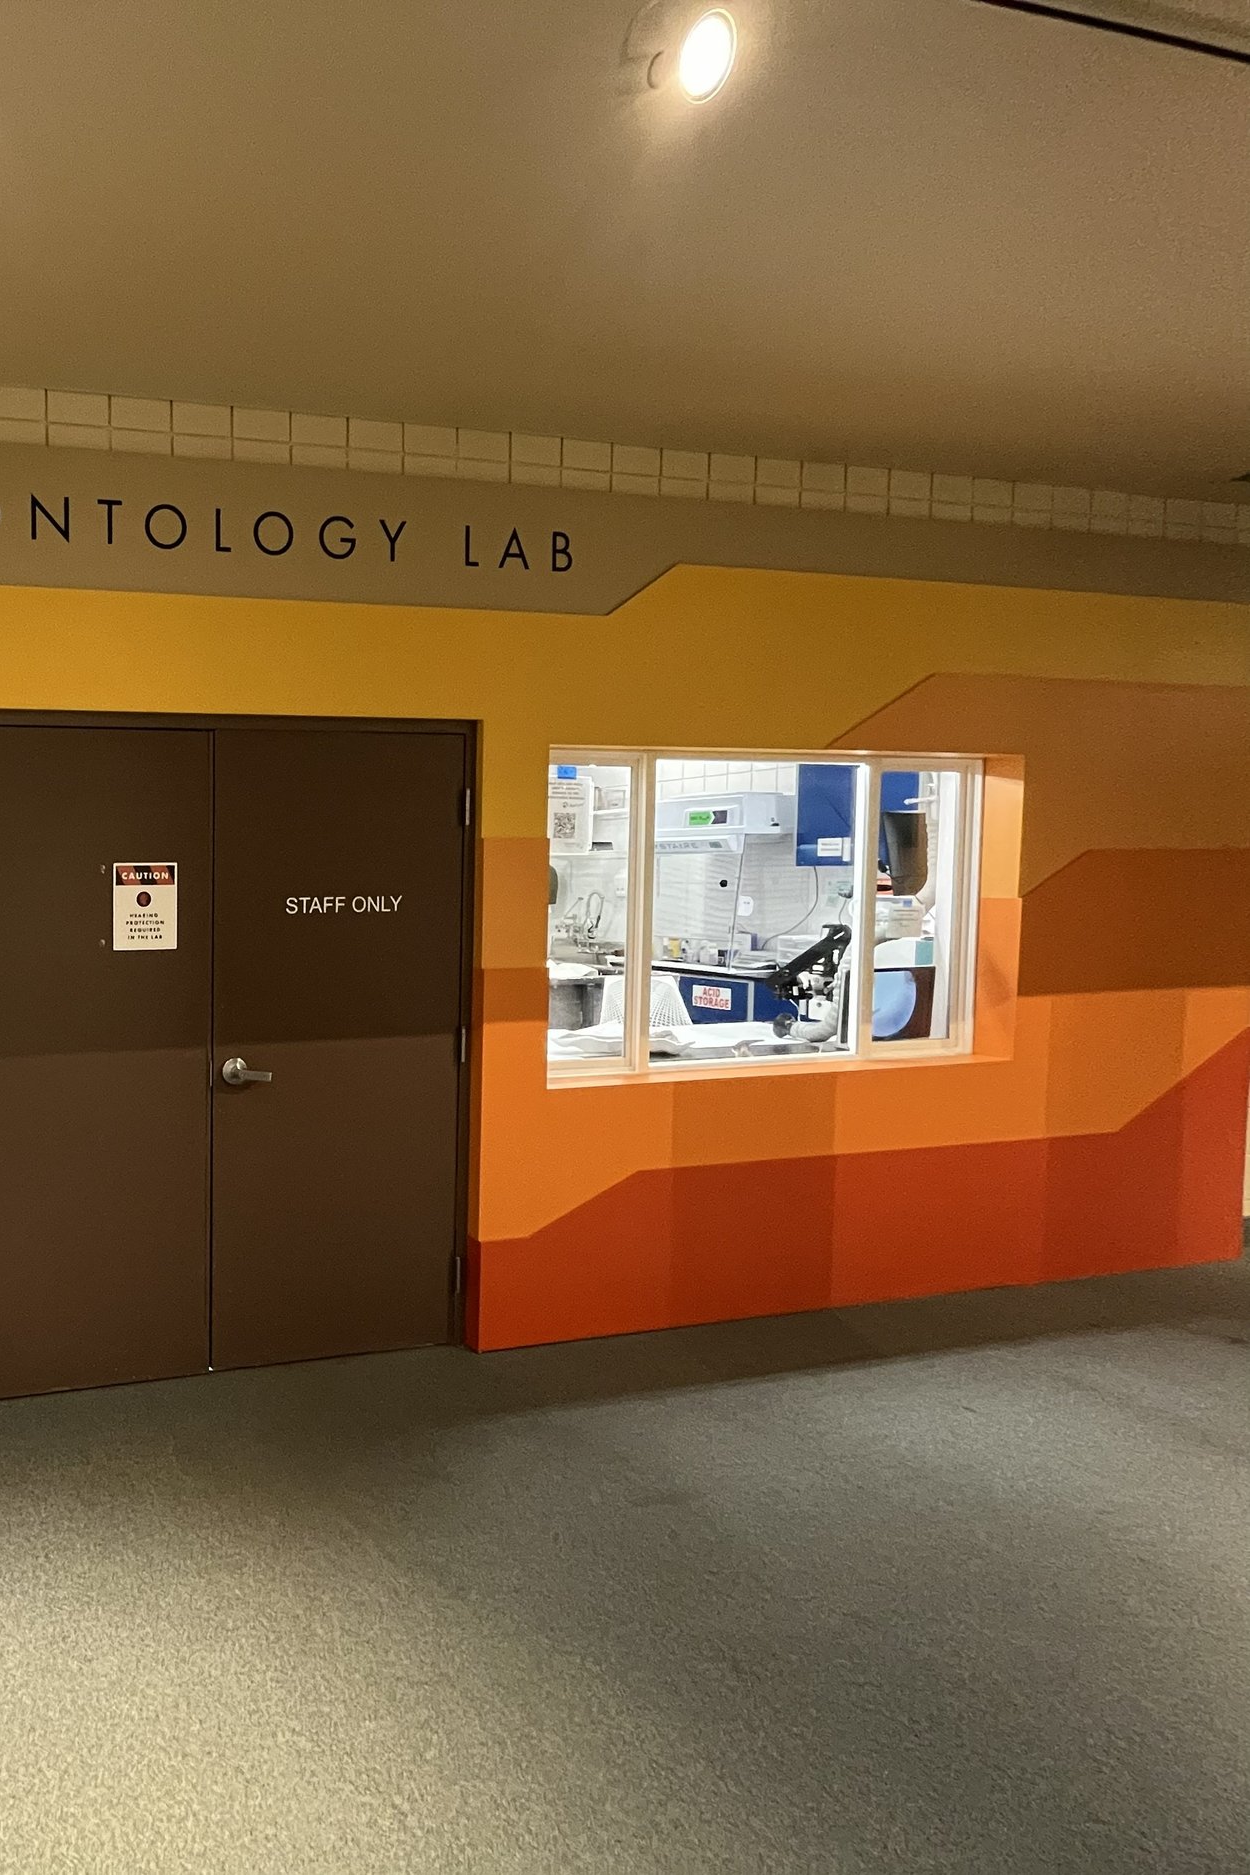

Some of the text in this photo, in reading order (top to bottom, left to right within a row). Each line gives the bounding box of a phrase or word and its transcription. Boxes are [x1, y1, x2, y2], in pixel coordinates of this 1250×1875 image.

[464, 525, 573, 572] LAB
[121, 872, 169, 880] CAUTION
[285, 895, 403, 915] STAFF ONLY
[702, 987, 720, 998] ACID
[693, 995, 729, 1009] STORAGE
